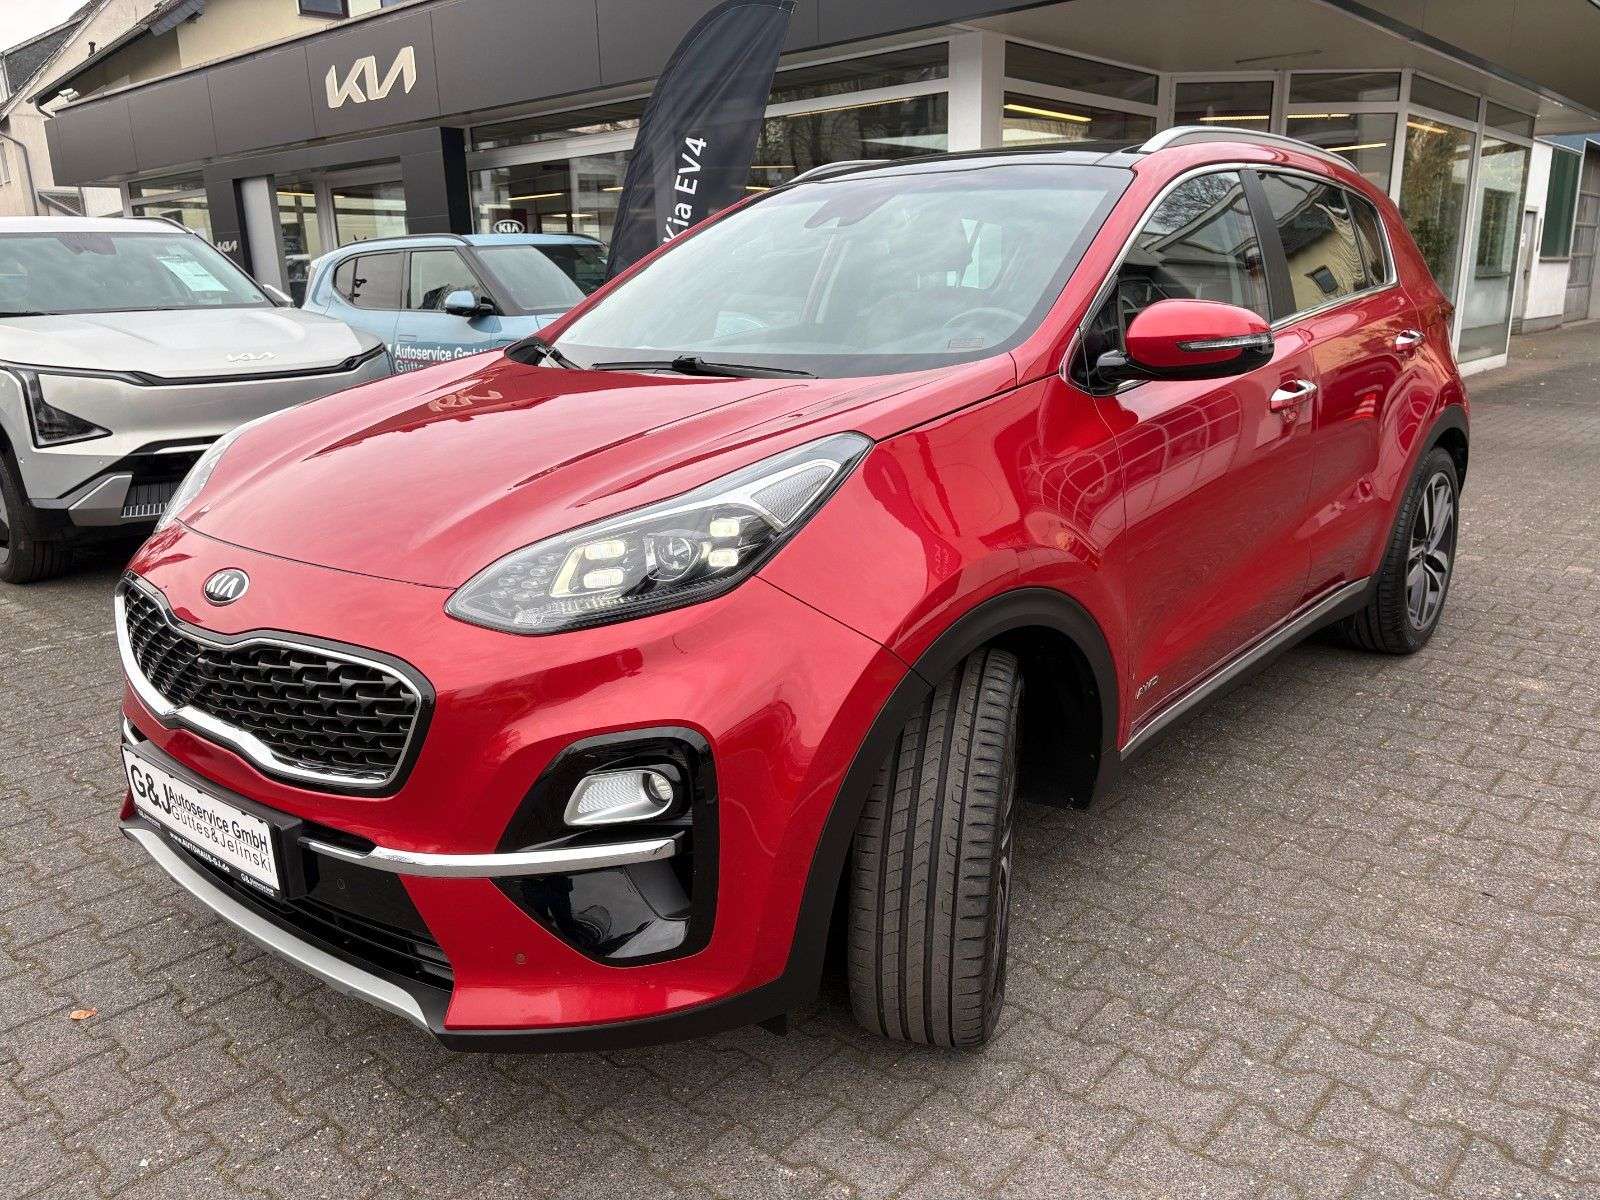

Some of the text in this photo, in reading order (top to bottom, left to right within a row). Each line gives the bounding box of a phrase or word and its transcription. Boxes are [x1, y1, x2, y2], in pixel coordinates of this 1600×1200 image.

[325, 45, 417, 108] KIA
[673, 136, 708, 195] EV4
[497, 221, 521, 233] KIA
[395, 343, 452, 361] Autoservice
[206, 572, 240, 598] KIA
[130, 764, 172, 815] G&J
[169, 789, 229, 832] Autoservice
[231, 820, 269, 854] GmbH
